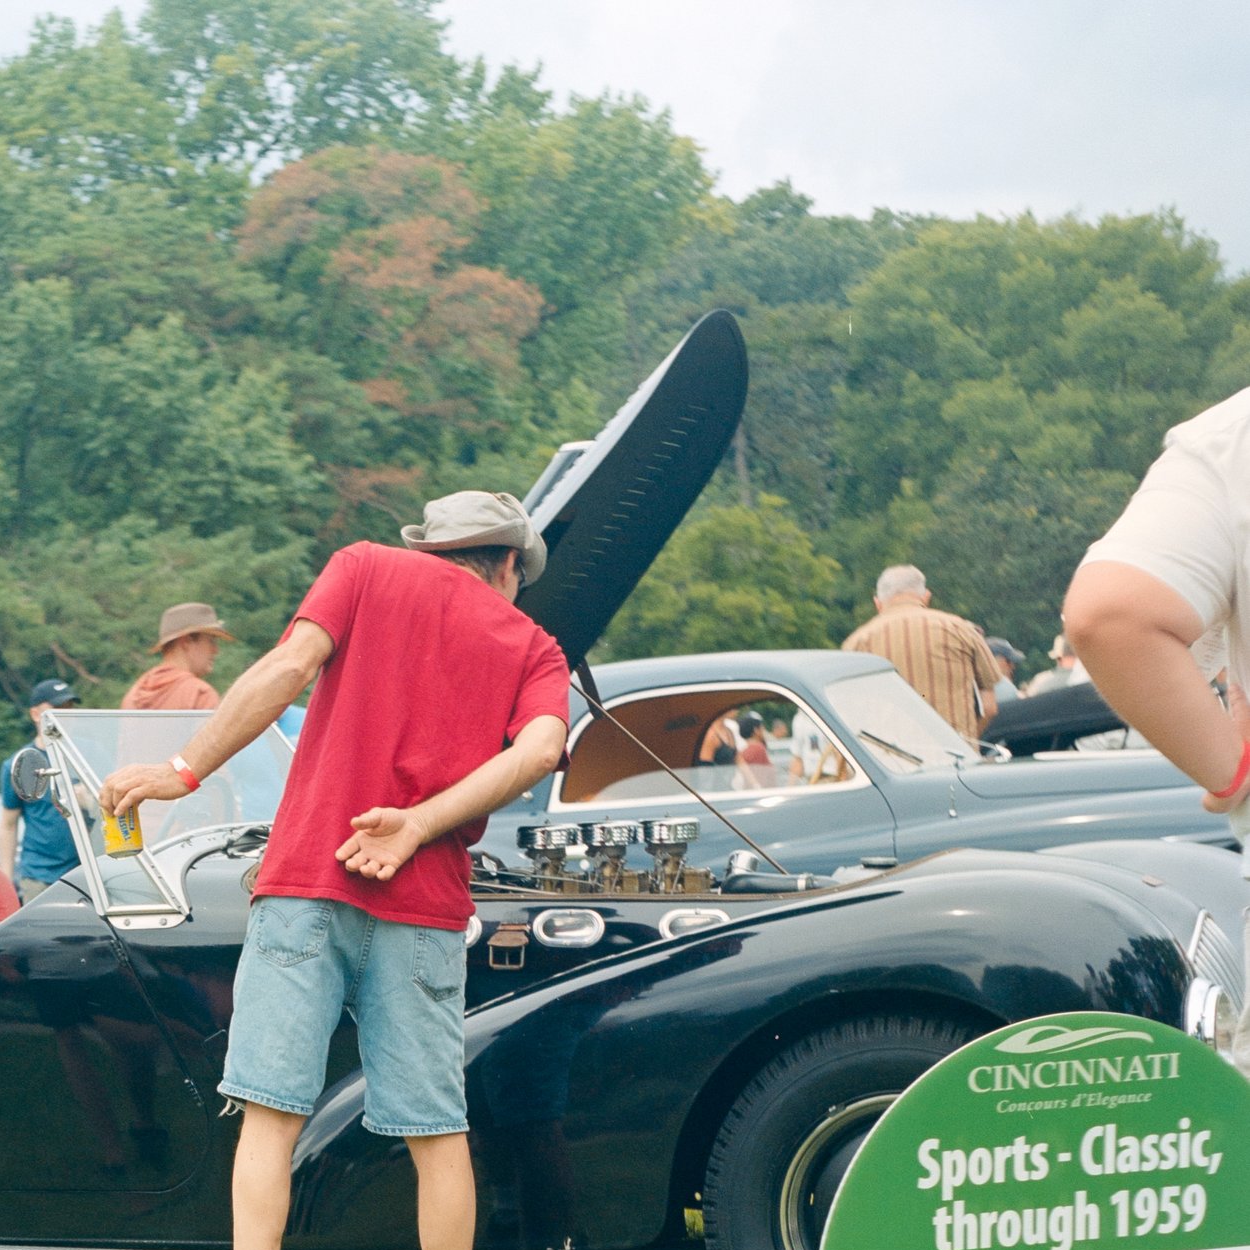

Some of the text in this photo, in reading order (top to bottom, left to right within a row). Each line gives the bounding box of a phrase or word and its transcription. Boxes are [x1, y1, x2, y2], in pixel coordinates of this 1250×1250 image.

[967, 1052, 1181, 1094] CINCINNATI
[996, 1099, 1068, 1114] Concours
[916, 1117, 1224, 1201] Sports - Classic,
[1109, 1183, 1208, 1238] 1959
